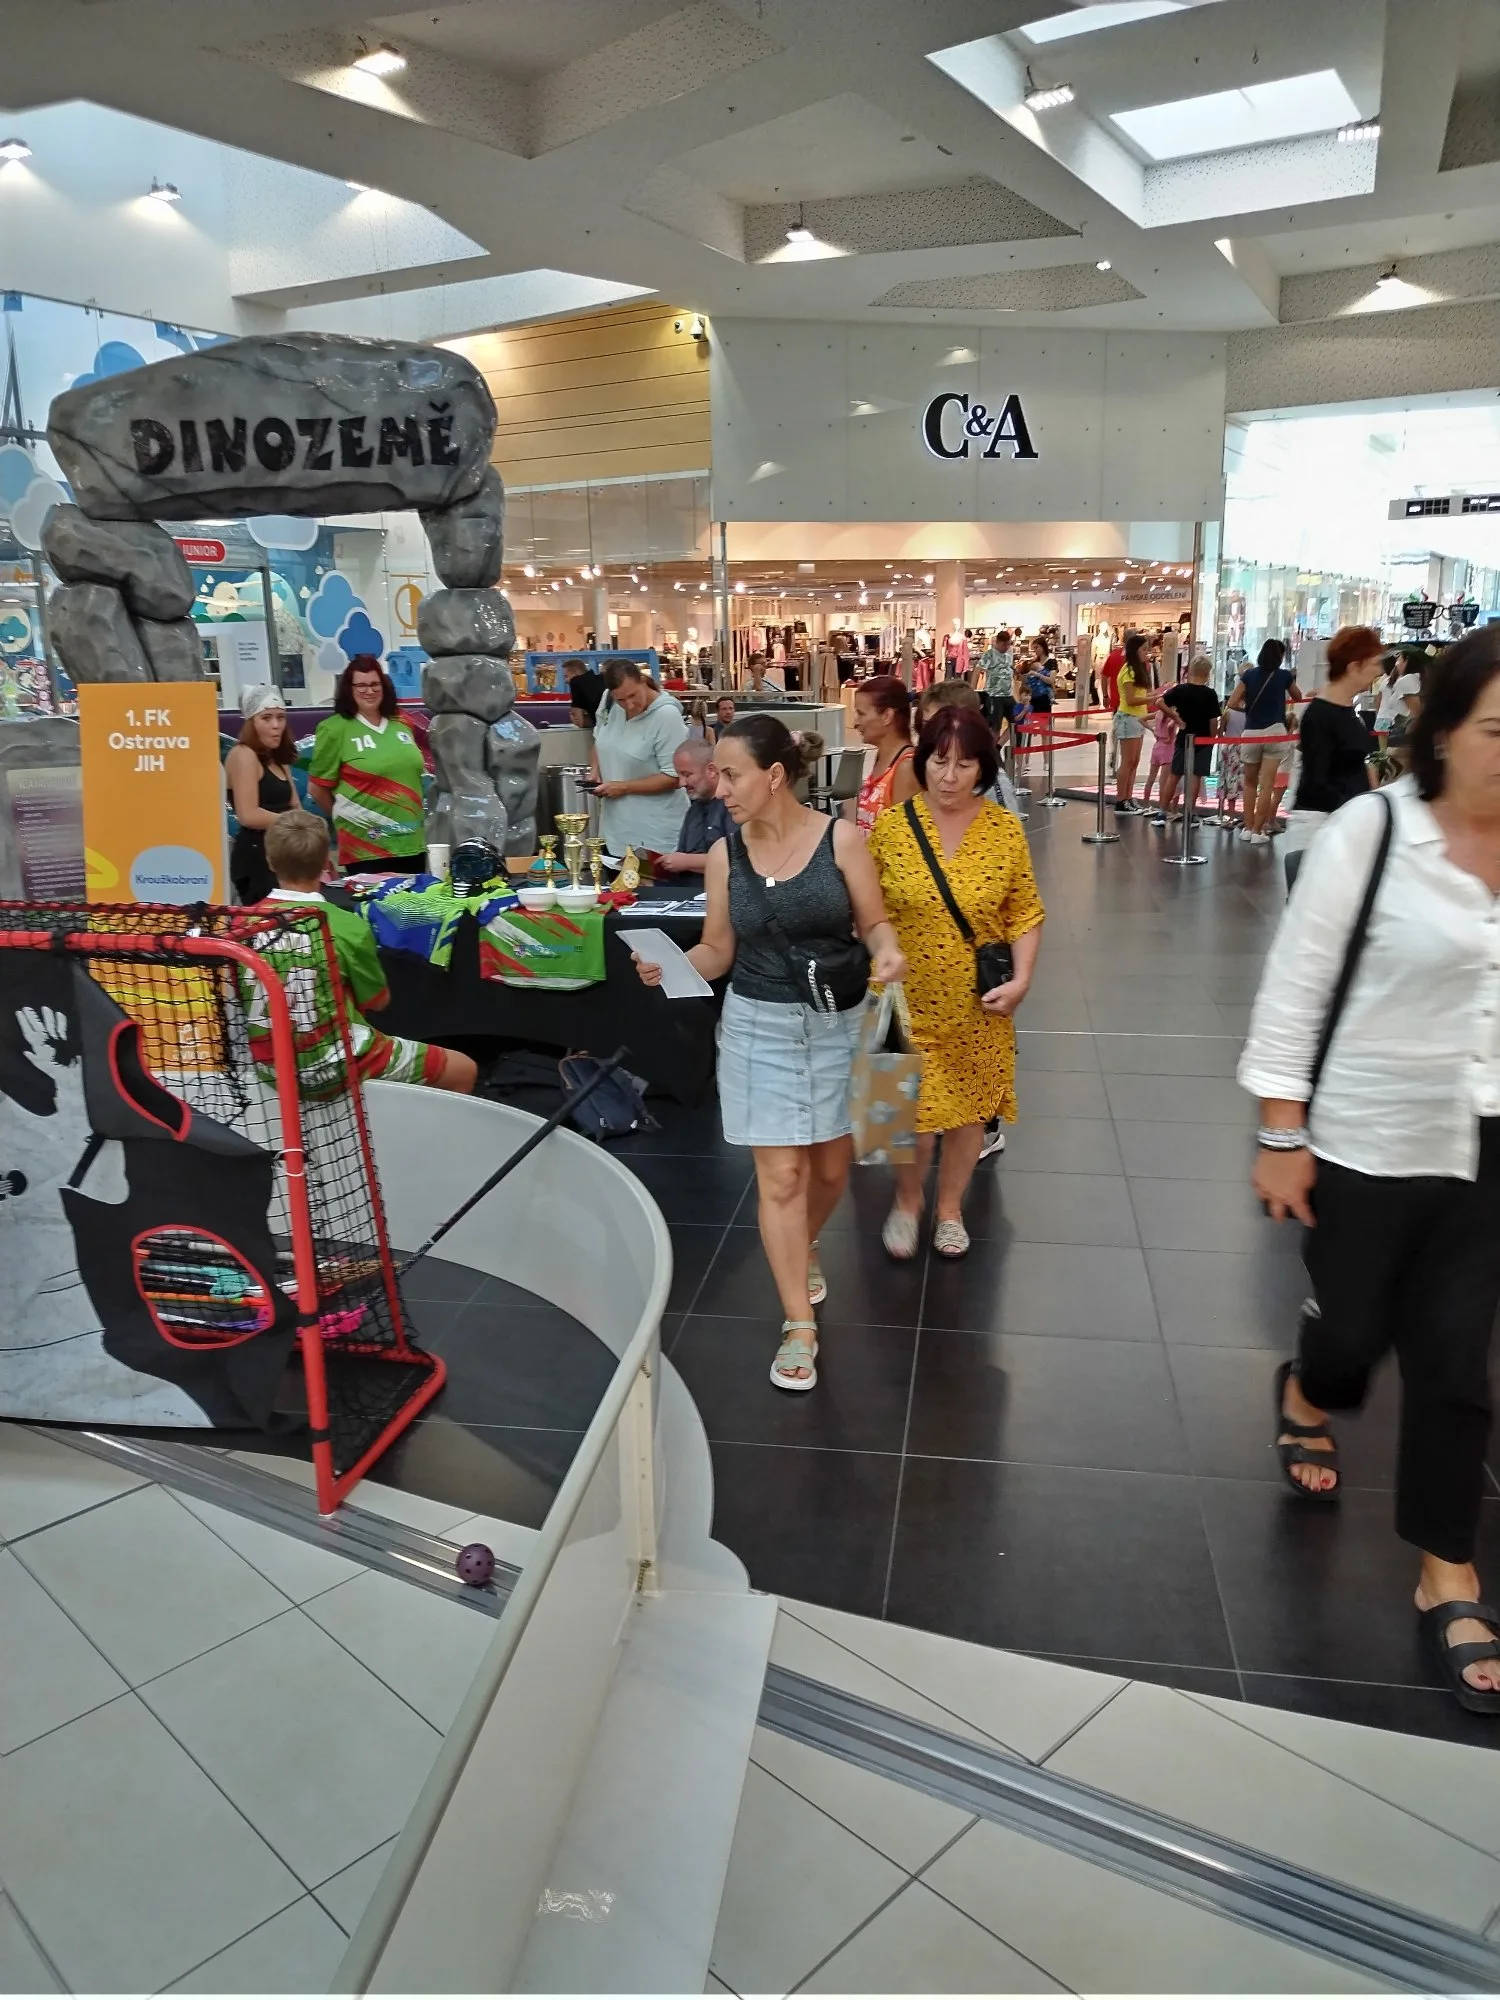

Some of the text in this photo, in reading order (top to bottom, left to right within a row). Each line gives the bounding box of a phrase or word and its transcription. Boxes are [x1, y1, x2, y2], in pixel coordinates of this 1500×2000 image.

[922, 392, 1039, 459] C&A
[129, 401, 462, 476] DINOZEMĚ
[125, 709, 172, 727] 1. FK
[108, 732, 190, 750] Ostrava
[134, 754, 165, 772] JIH
[135, 873, 209, 886] Kroužkobraní
